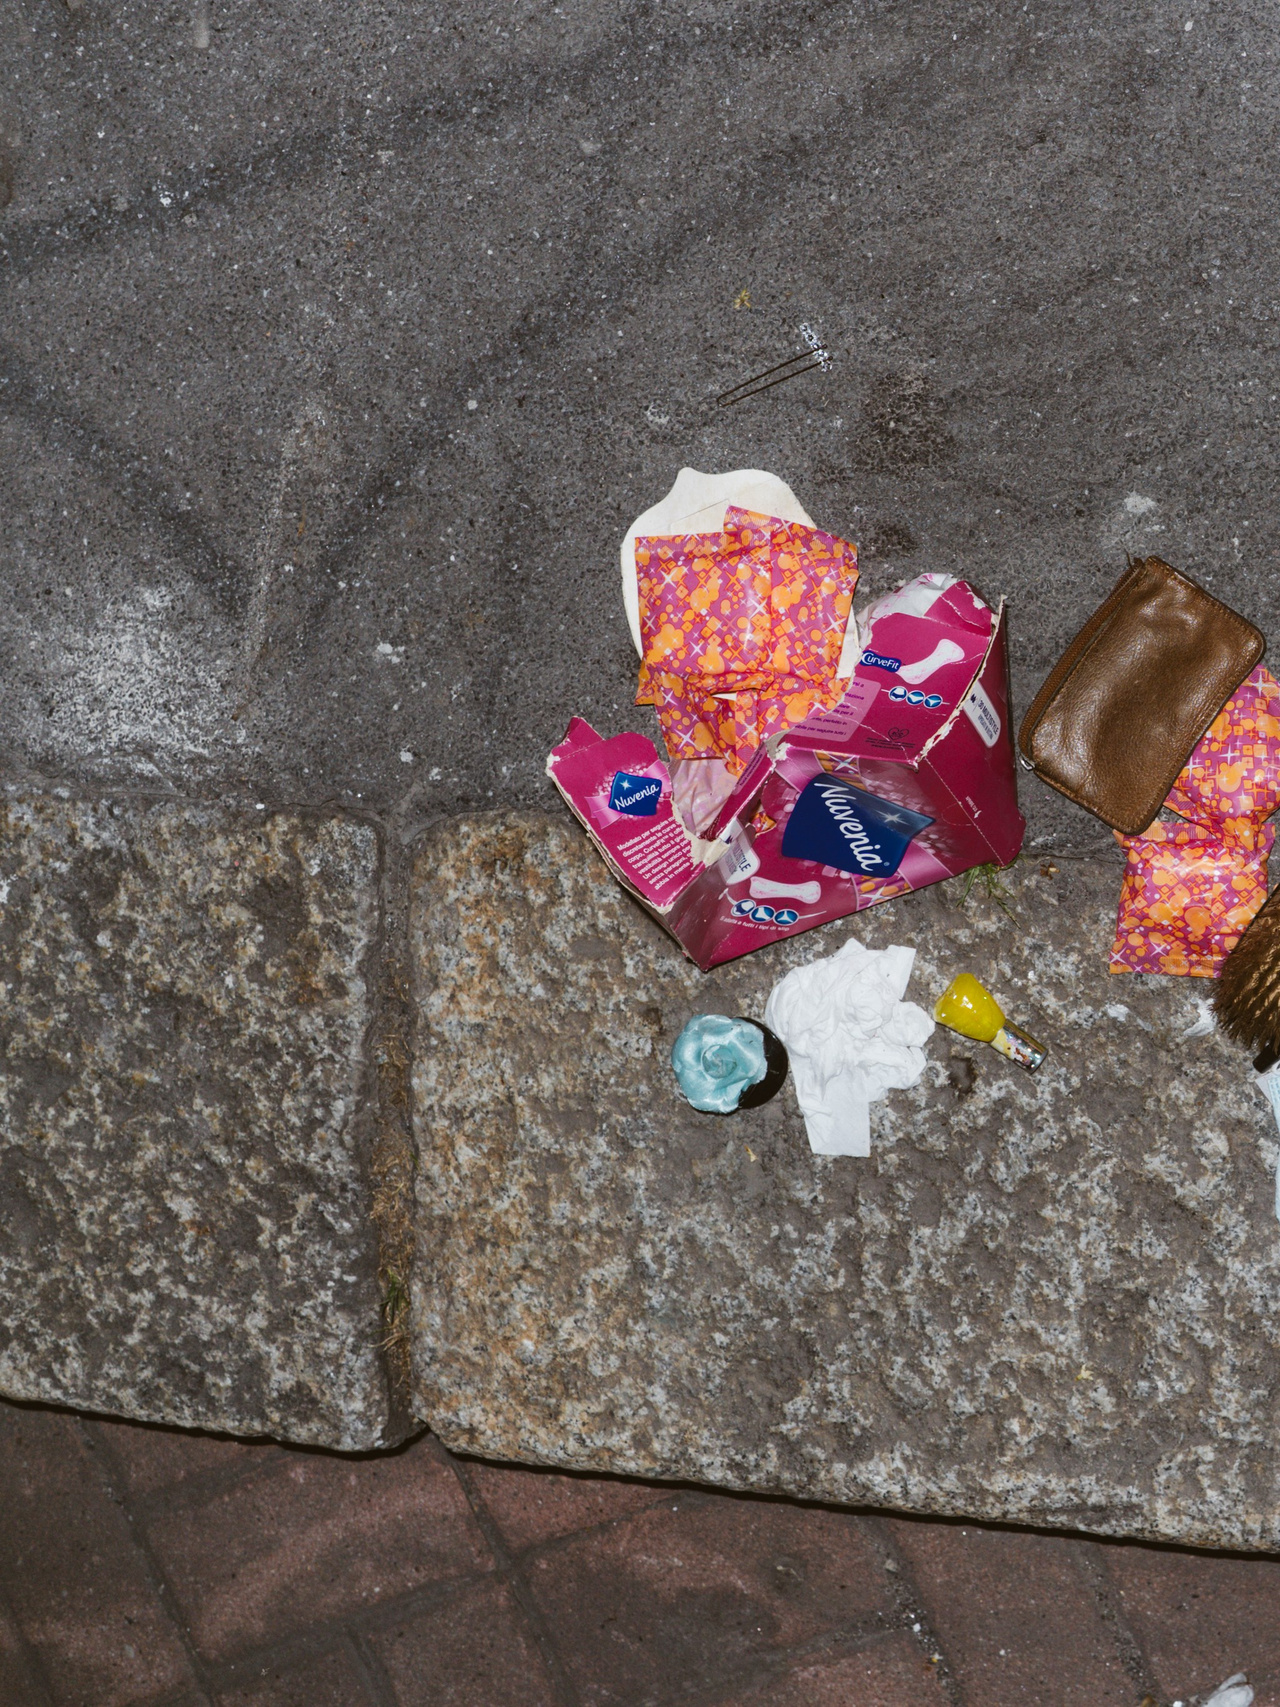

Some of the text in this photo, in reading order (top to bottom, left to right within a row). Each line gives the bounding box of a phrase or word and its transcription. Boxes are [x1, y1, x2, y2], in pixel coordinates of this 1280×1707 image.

[861, 651, 900, 670] CurveFit
[614, 784, 659, 810] Nuvenia
[617, 835, 642, 851] Modellato
[641, 831, 650, 839] per
[650, 820, 669, 833] seguire
[813, 781, 883, 871] Nuvenia
[622, 835, 657, 857] discretamente
[662, 824, 677, 834] curve
[632, 850, 659, 870] tranquillità
[658, 843, 671, 853] tutto
[638, 856, 662, 875] vestibilità
[661, 845, 681, 859] sempre
[651, 861, 669, 874] design
[667, 850, 683, 863] unico
[649, 872, 665, 885] senza
[654, 877, 669, 890] abbia
[674, 862, 690, 875] mente
